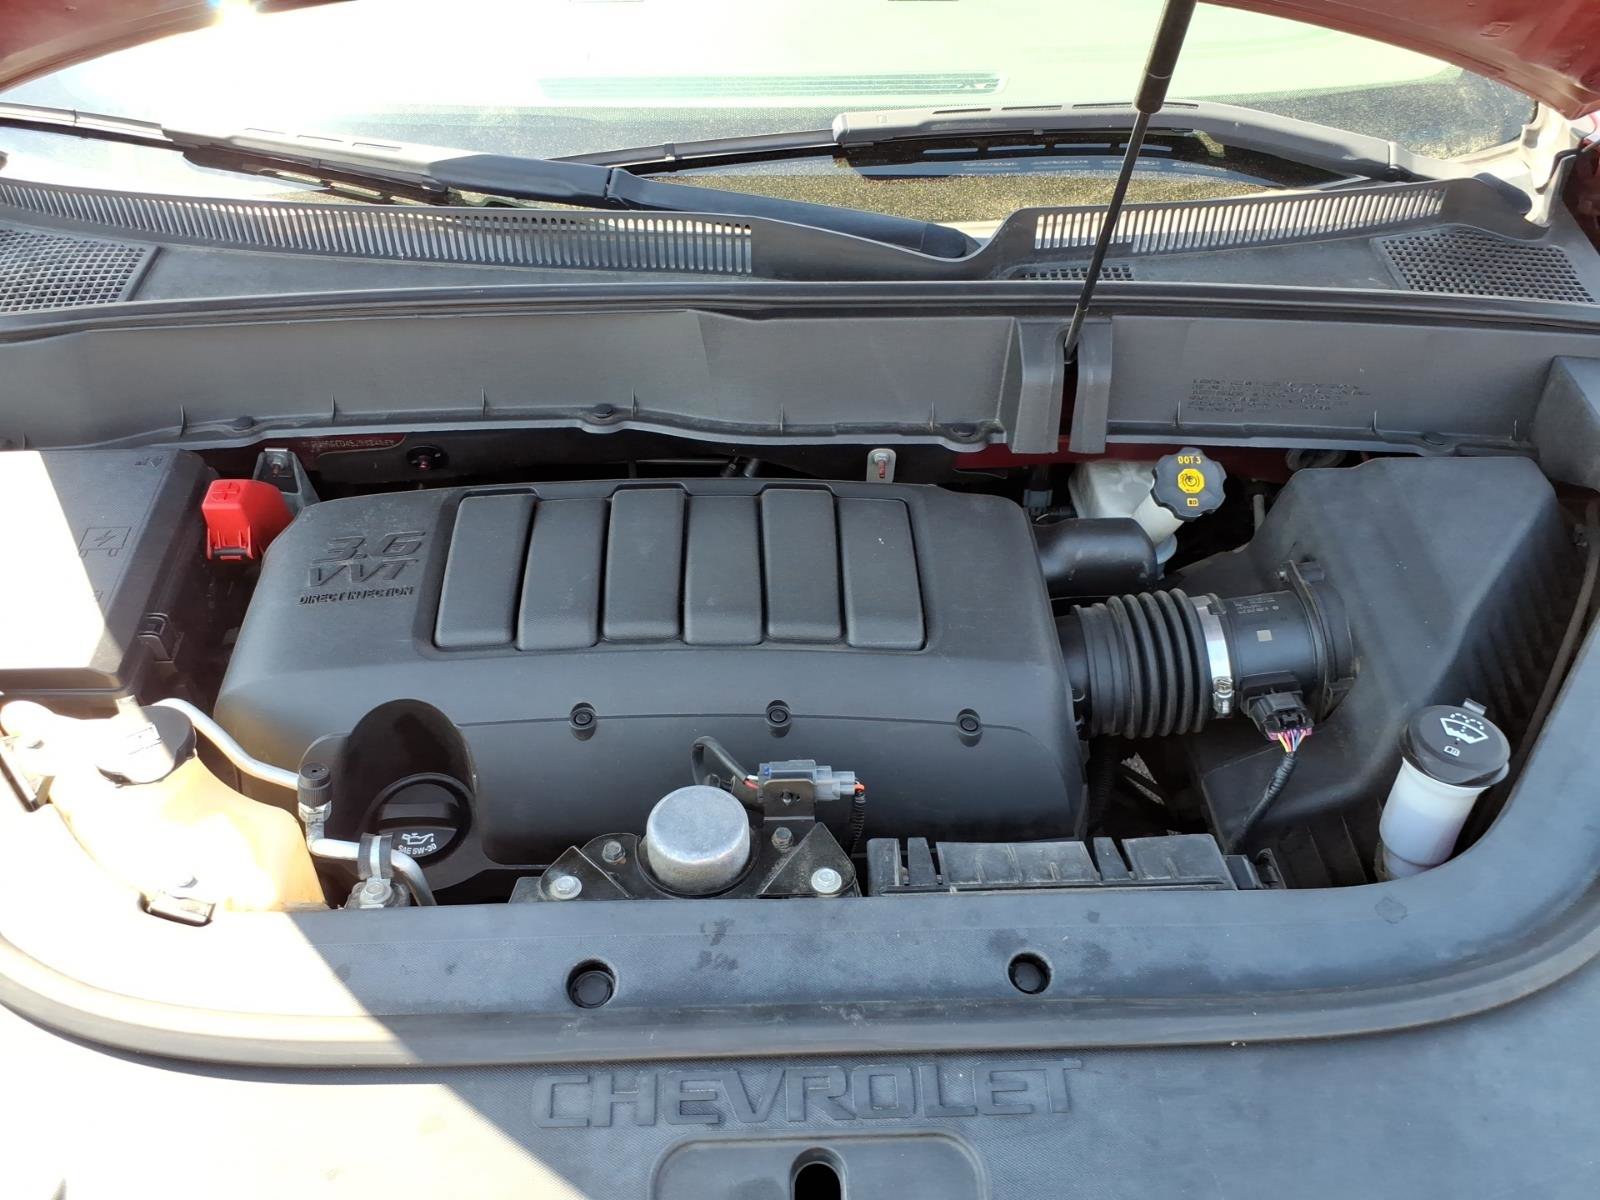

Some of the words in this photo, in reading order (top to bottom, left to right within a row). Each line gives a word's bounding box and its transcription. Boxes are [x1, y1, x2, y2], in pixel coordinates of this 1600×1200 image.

[1178, 455, 1195, 464] DOT
[311, 531, 426, 563] 3.6
[308, 558, 419, 588] VVT
[299, 591, 346, 605] DIRECT
[347, 586, 415, 601] INJECTION
[398, 845, 412, 855] SAE
[412, 843, 437, 855] 5W-30
[532, 1058, 1083, 1128] CHEVROLET
